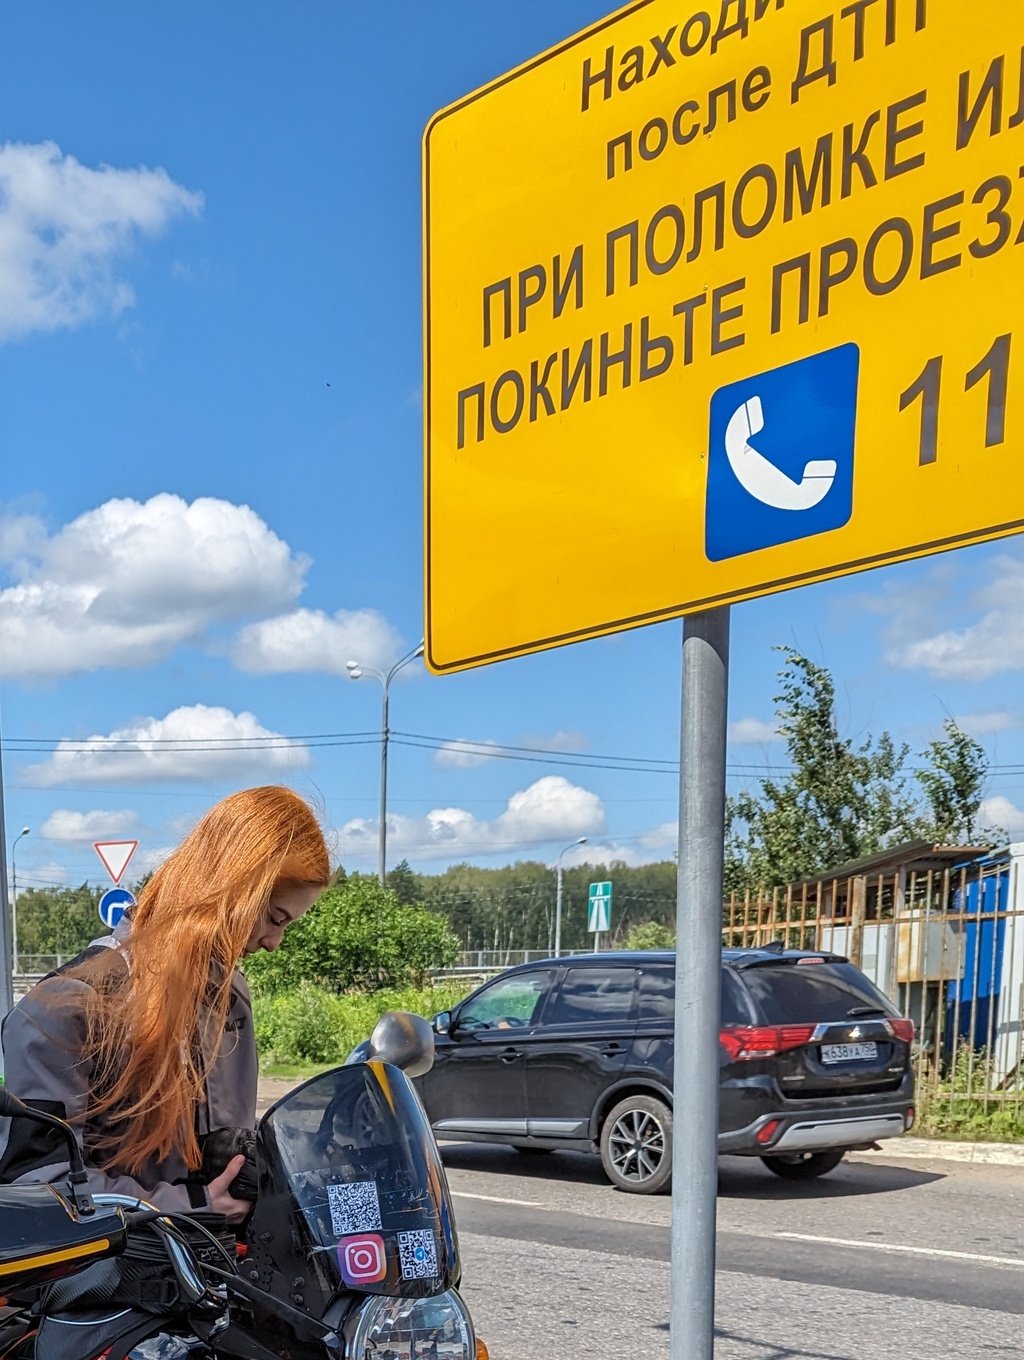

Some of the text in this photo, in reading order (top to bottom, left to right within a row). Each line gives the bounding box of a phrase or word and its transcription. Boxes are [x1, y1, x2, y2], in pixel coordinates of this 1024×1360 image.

[483, 244, 584, 349] ПРИ
[606, 89, 927, 297] ПОЛОМКЕ
[607, 66, 772, 180] после
[457, 165, 1024, 451] ПОКИНЬТЕ ПРОЕЗ
[899, 332, 1012, 467] 11
